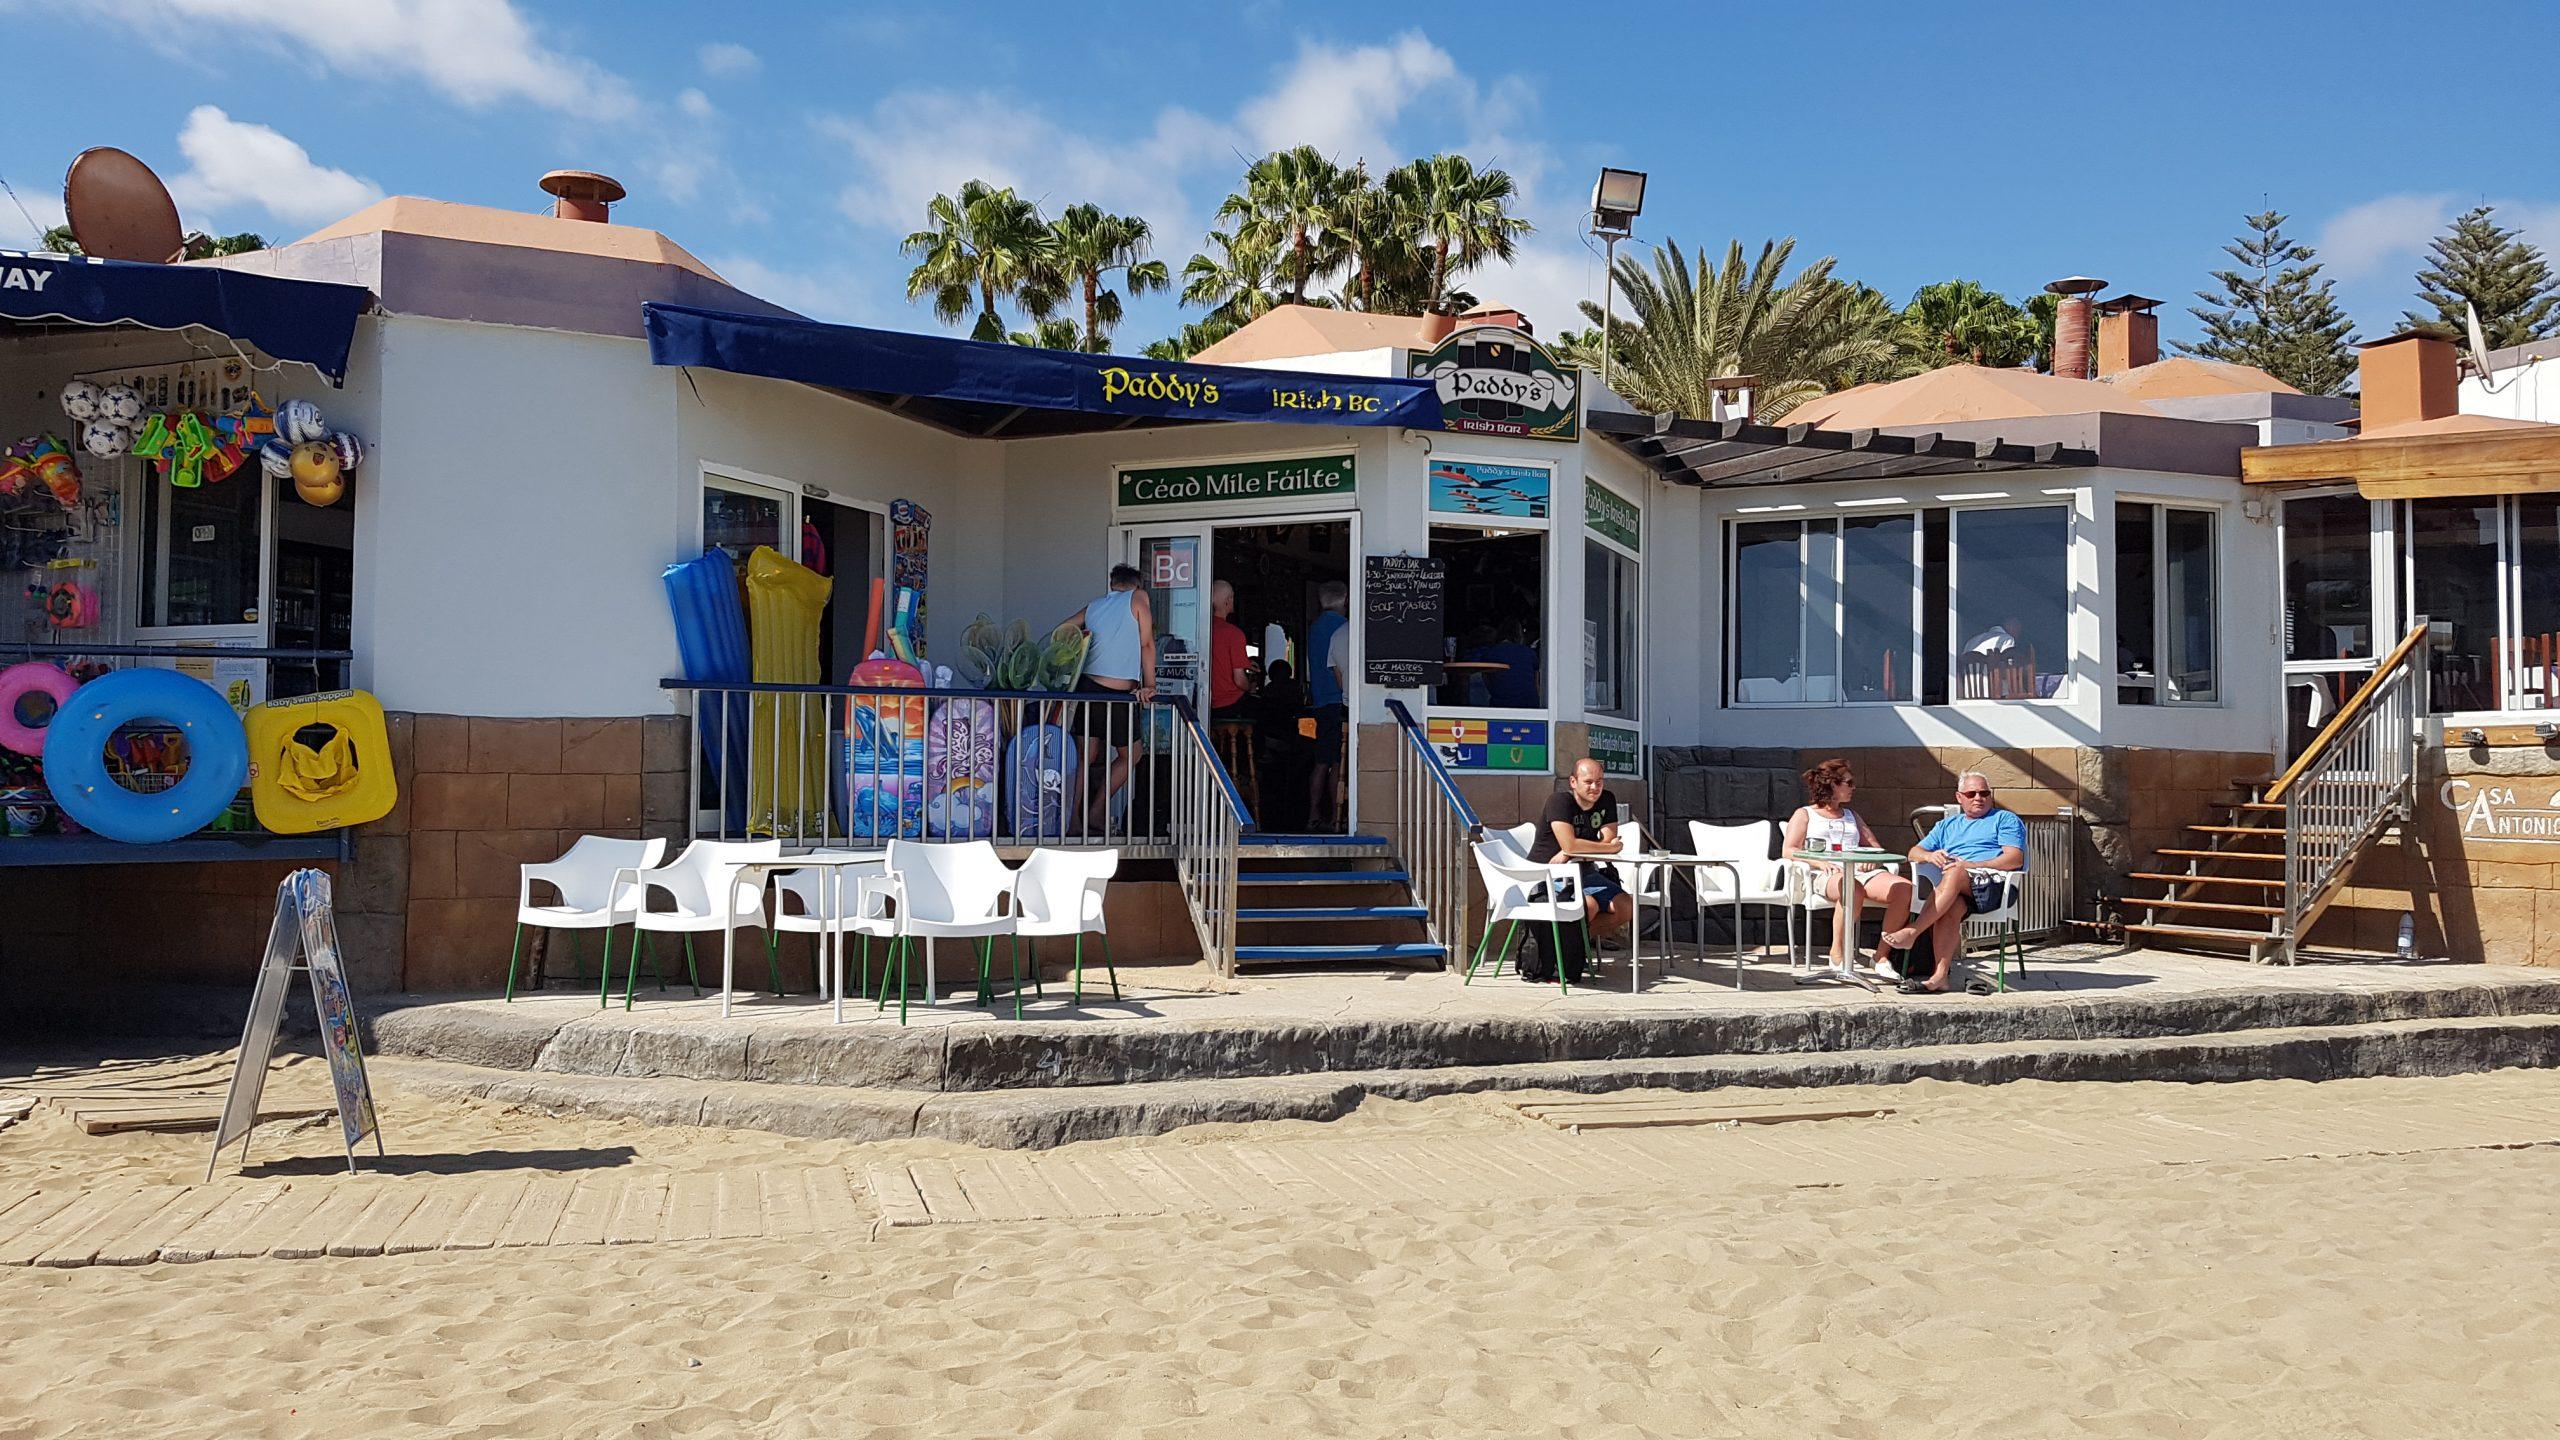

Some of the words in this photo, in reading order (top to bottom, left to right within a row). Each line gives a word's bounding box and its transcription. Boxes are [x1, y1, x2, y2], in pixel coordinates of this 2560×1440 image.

[0, 266, 53, 292] AY
[1099, 367, 1219, 408] Paddy's
[1451, 372, 1542, 402] Paddy's
[1135, 476, 1200, 500] Céad
[1206, 472, 1260, 496] Míle
[1267, 468, 1340, 492] Fáilte
[1407, 559, 1420, 569] BAR
[1369, 600, 1394, 612] GOLF
[1397, 600, 1437, 618] MASTERS
[1166, 667, 1195, 679] MUSIC
[1369, 663, 1387, 671] GOLF
[1391, 664, 1423, 672] MASTERS
[292, 694, 317, 704] Swim
[318, 690, 353, 701] Support
